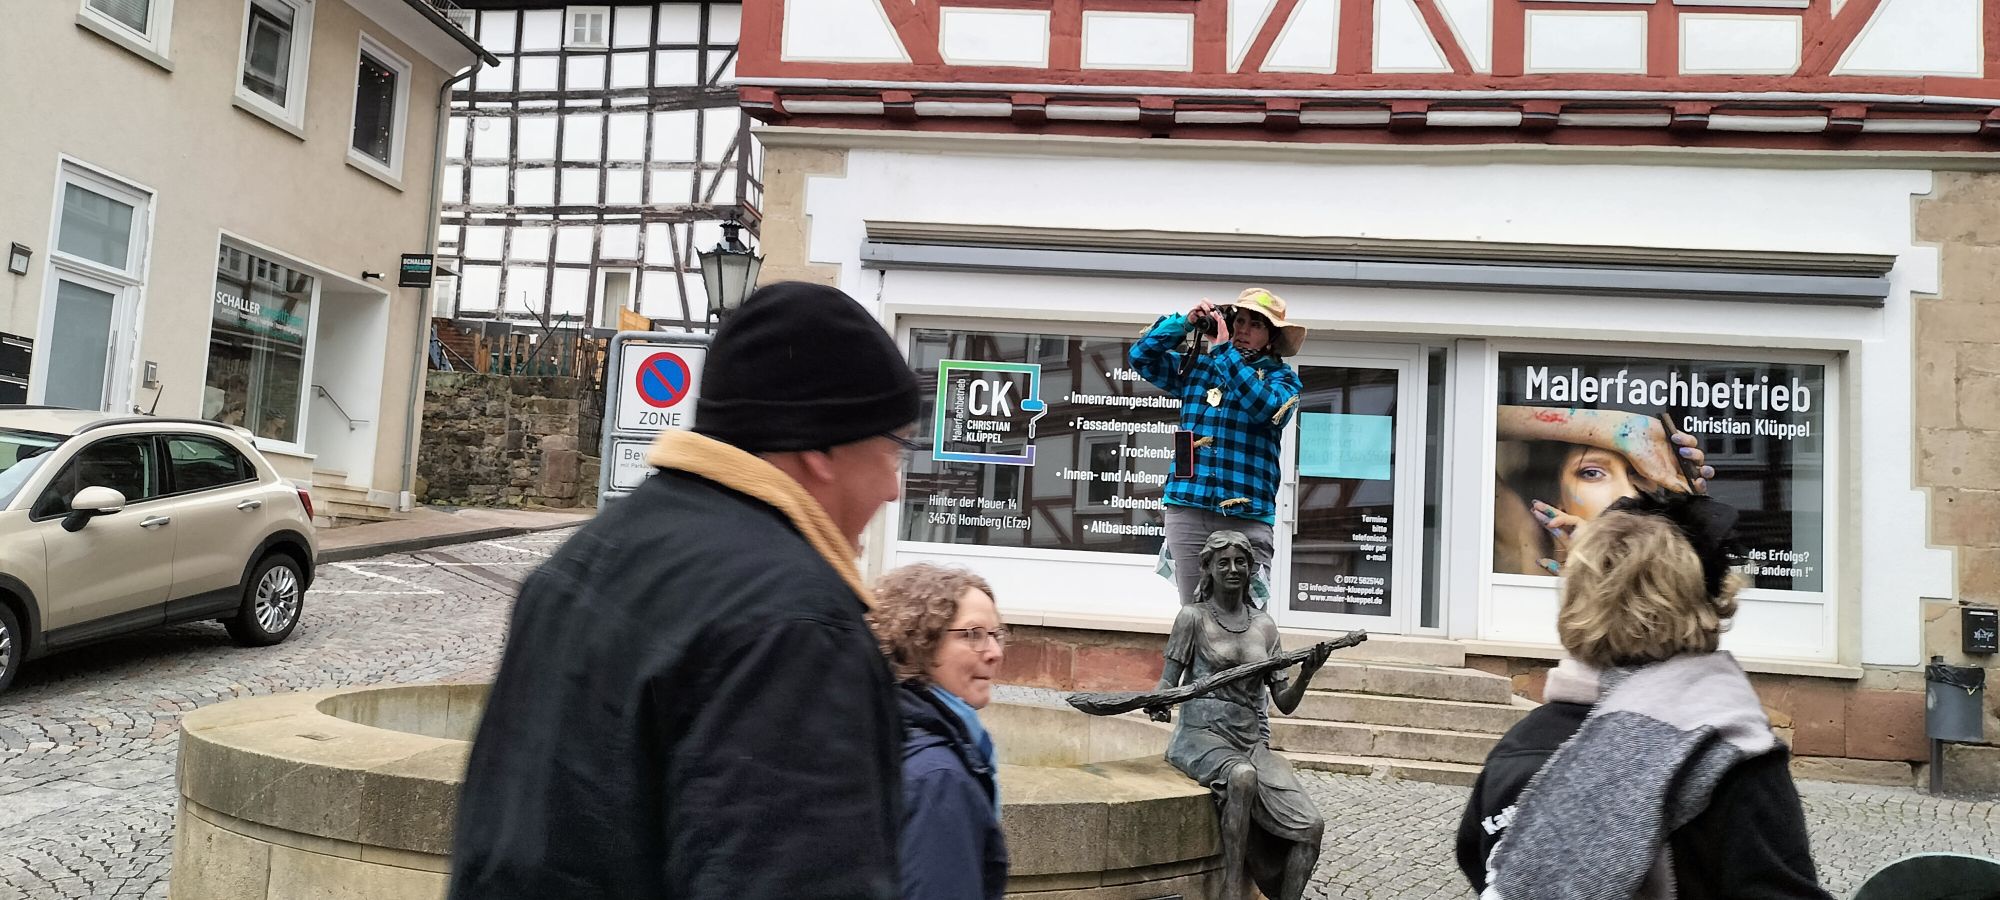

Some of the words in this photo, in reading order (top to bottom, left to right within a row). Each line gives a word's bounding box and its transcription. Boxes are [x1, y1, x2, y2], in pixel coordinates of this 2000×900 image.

[216, 291, 260, 315] SCHALLER
[1525, 365, 1811, 413] Malerfachbetrieb
[968, 379, 1013, 417] CK
[1071, 391, 1182, 409] Innenraumgestaltun
[952, 378, 966, 441] Malerfachbetrieb
[639, 412, 681, 426] ZONE
[967, 420, 1011, 432] CHRISTIAN
[1077, 417, 1179, 435] Fassadengestaltun
[1683, 415, 1751, 435] Christian
[1755, 419, 1810, 440] Klüppel
[966, 430, 1003, 444] KLÜPPEL
[1119, 445, 1176, 459] Trockenba
[1063, 467, 1099, 480] Innen-
[1101, 470, 1121, 482] und
[929, 494, 957, 507] Hinter
[959, 496, 975, 508] der
[977, 497, 1005, 509] Mauer
[1008, 498, 1017, 510] 14
[928, 512, 956, 525] 34576
[958, 513, 1001, 530] Homberg
[1003, 515, 1031, 530] (Efze)
[1361, 514, 1388, 524] Termine
[1091, 520, 1166, 537] Altbausanieru
[1372, 525, 1388, 533] bitte
[1352, 533, 1387, 543] telefonisch
[1360, 543, 1375, 551] oder
[1375, 545, 1387, 553] per
[1749, 548, 1767, 560] des
[1769, 549, 1810, 564] Erfolgs?
[1744, 563, 1759, 575] die
[1761, 565, 1803, 577] anderen
[1344, 576, 1358, 584] 0172
[1309, 583, 1384, 595] info@maler-klueppel.de
[1309, 594, 1383, 605] www.maler-klueppel.de
